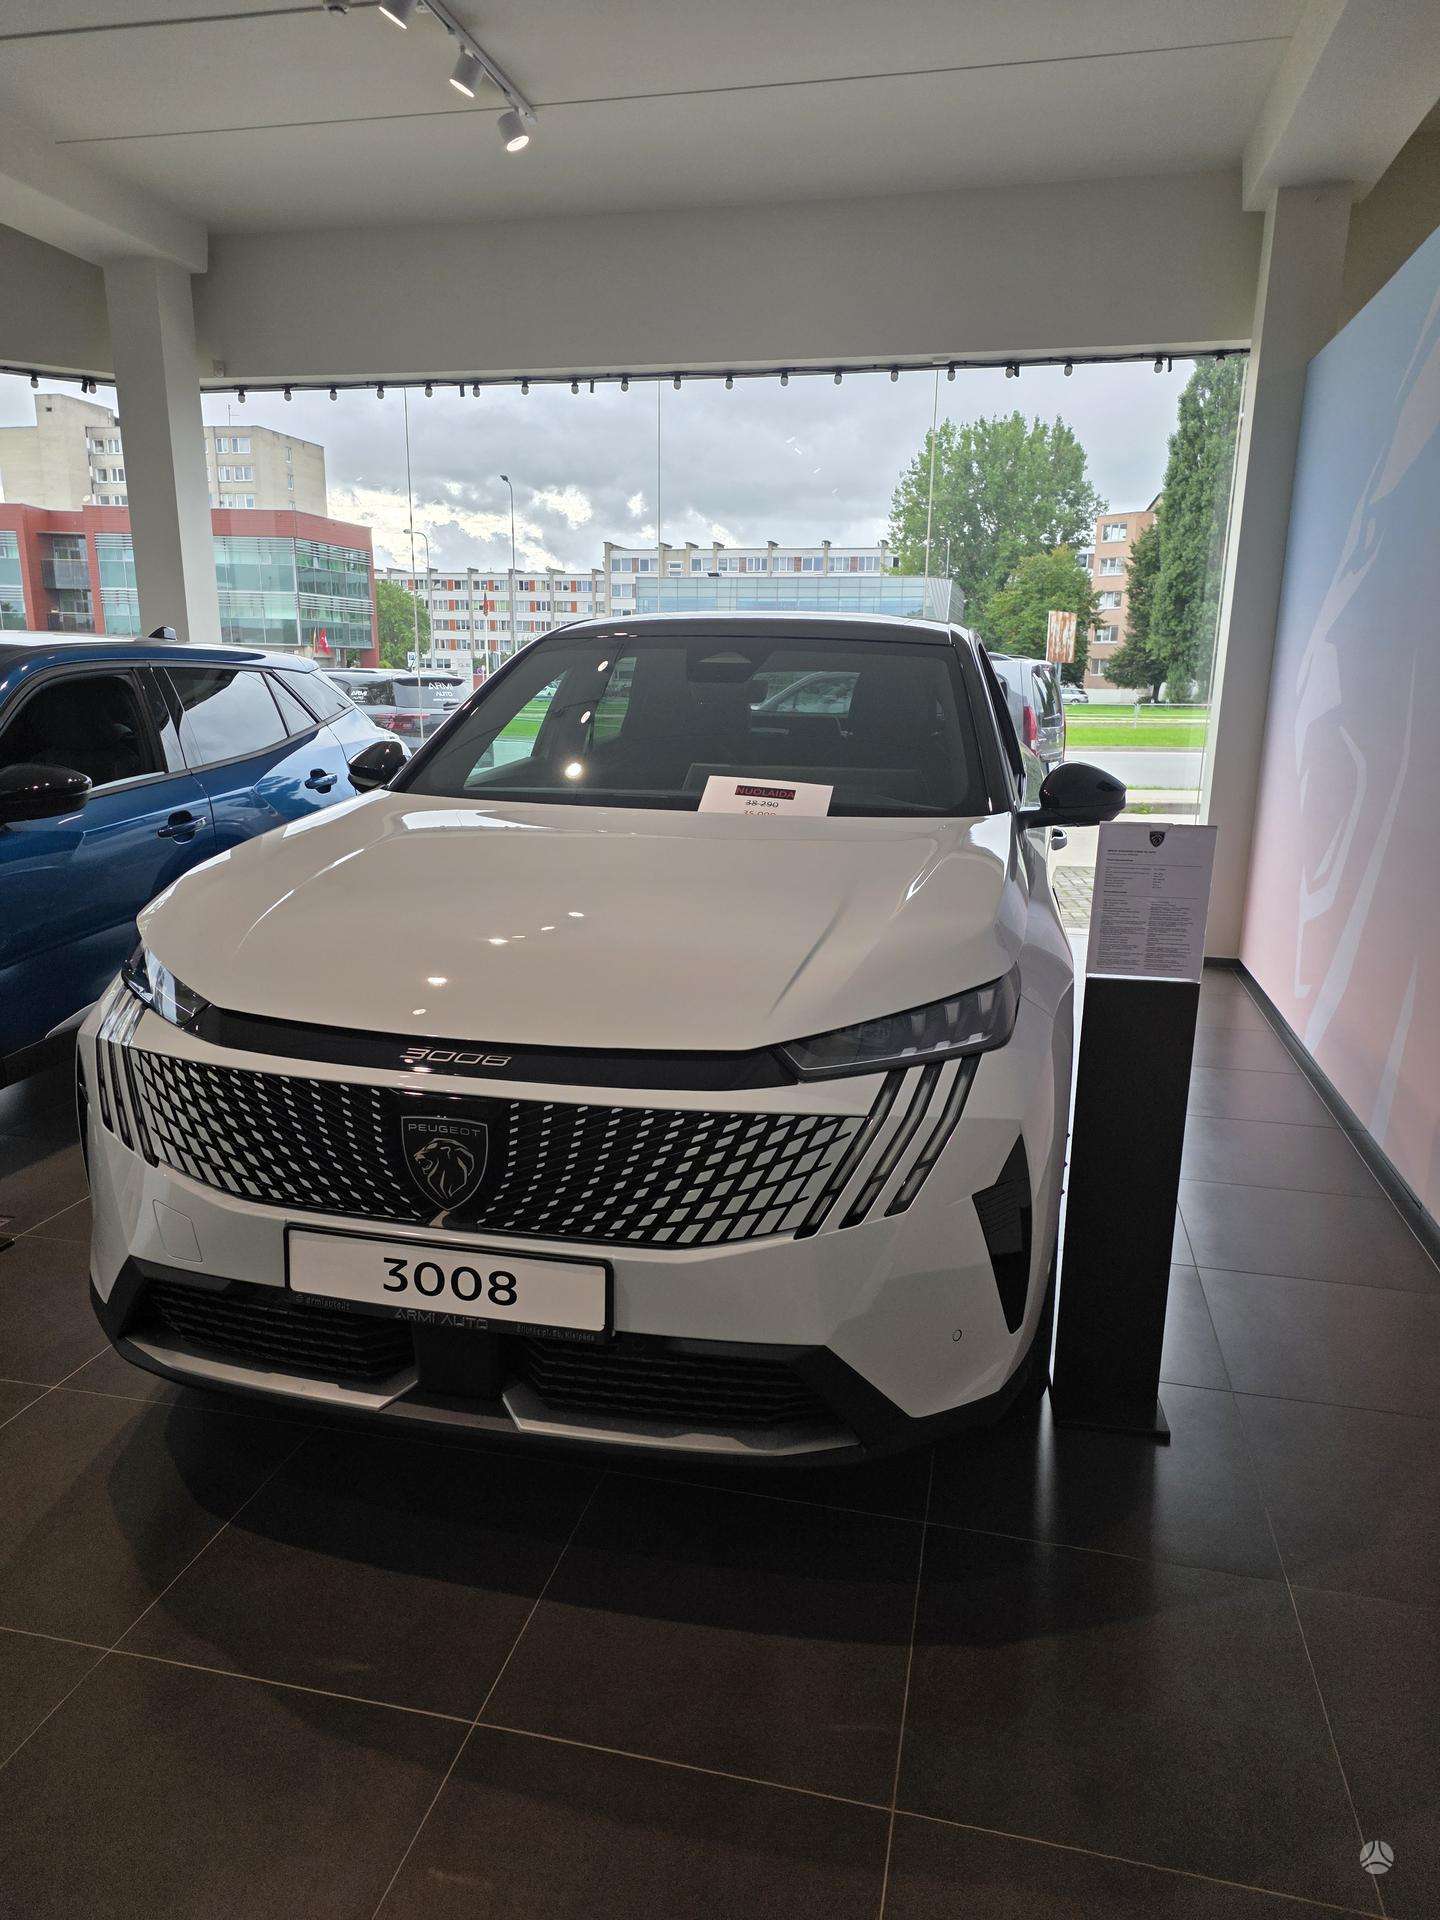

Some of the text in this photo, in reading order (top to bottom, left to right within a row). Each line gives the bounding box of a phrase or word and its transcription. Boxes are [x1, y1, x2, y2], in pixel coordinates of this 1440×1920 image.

[428, 682, 453, 690] ARMI
[736, 785, 795, 799] NUOLAIDA
[400, 1047, 512, 1066] 3008
[408, 1123, 481, 1136] PEUGEOT
[383, 1257, 518, 1306] 3008
[394, 1308, 489, 1330] ARMI AUTO
